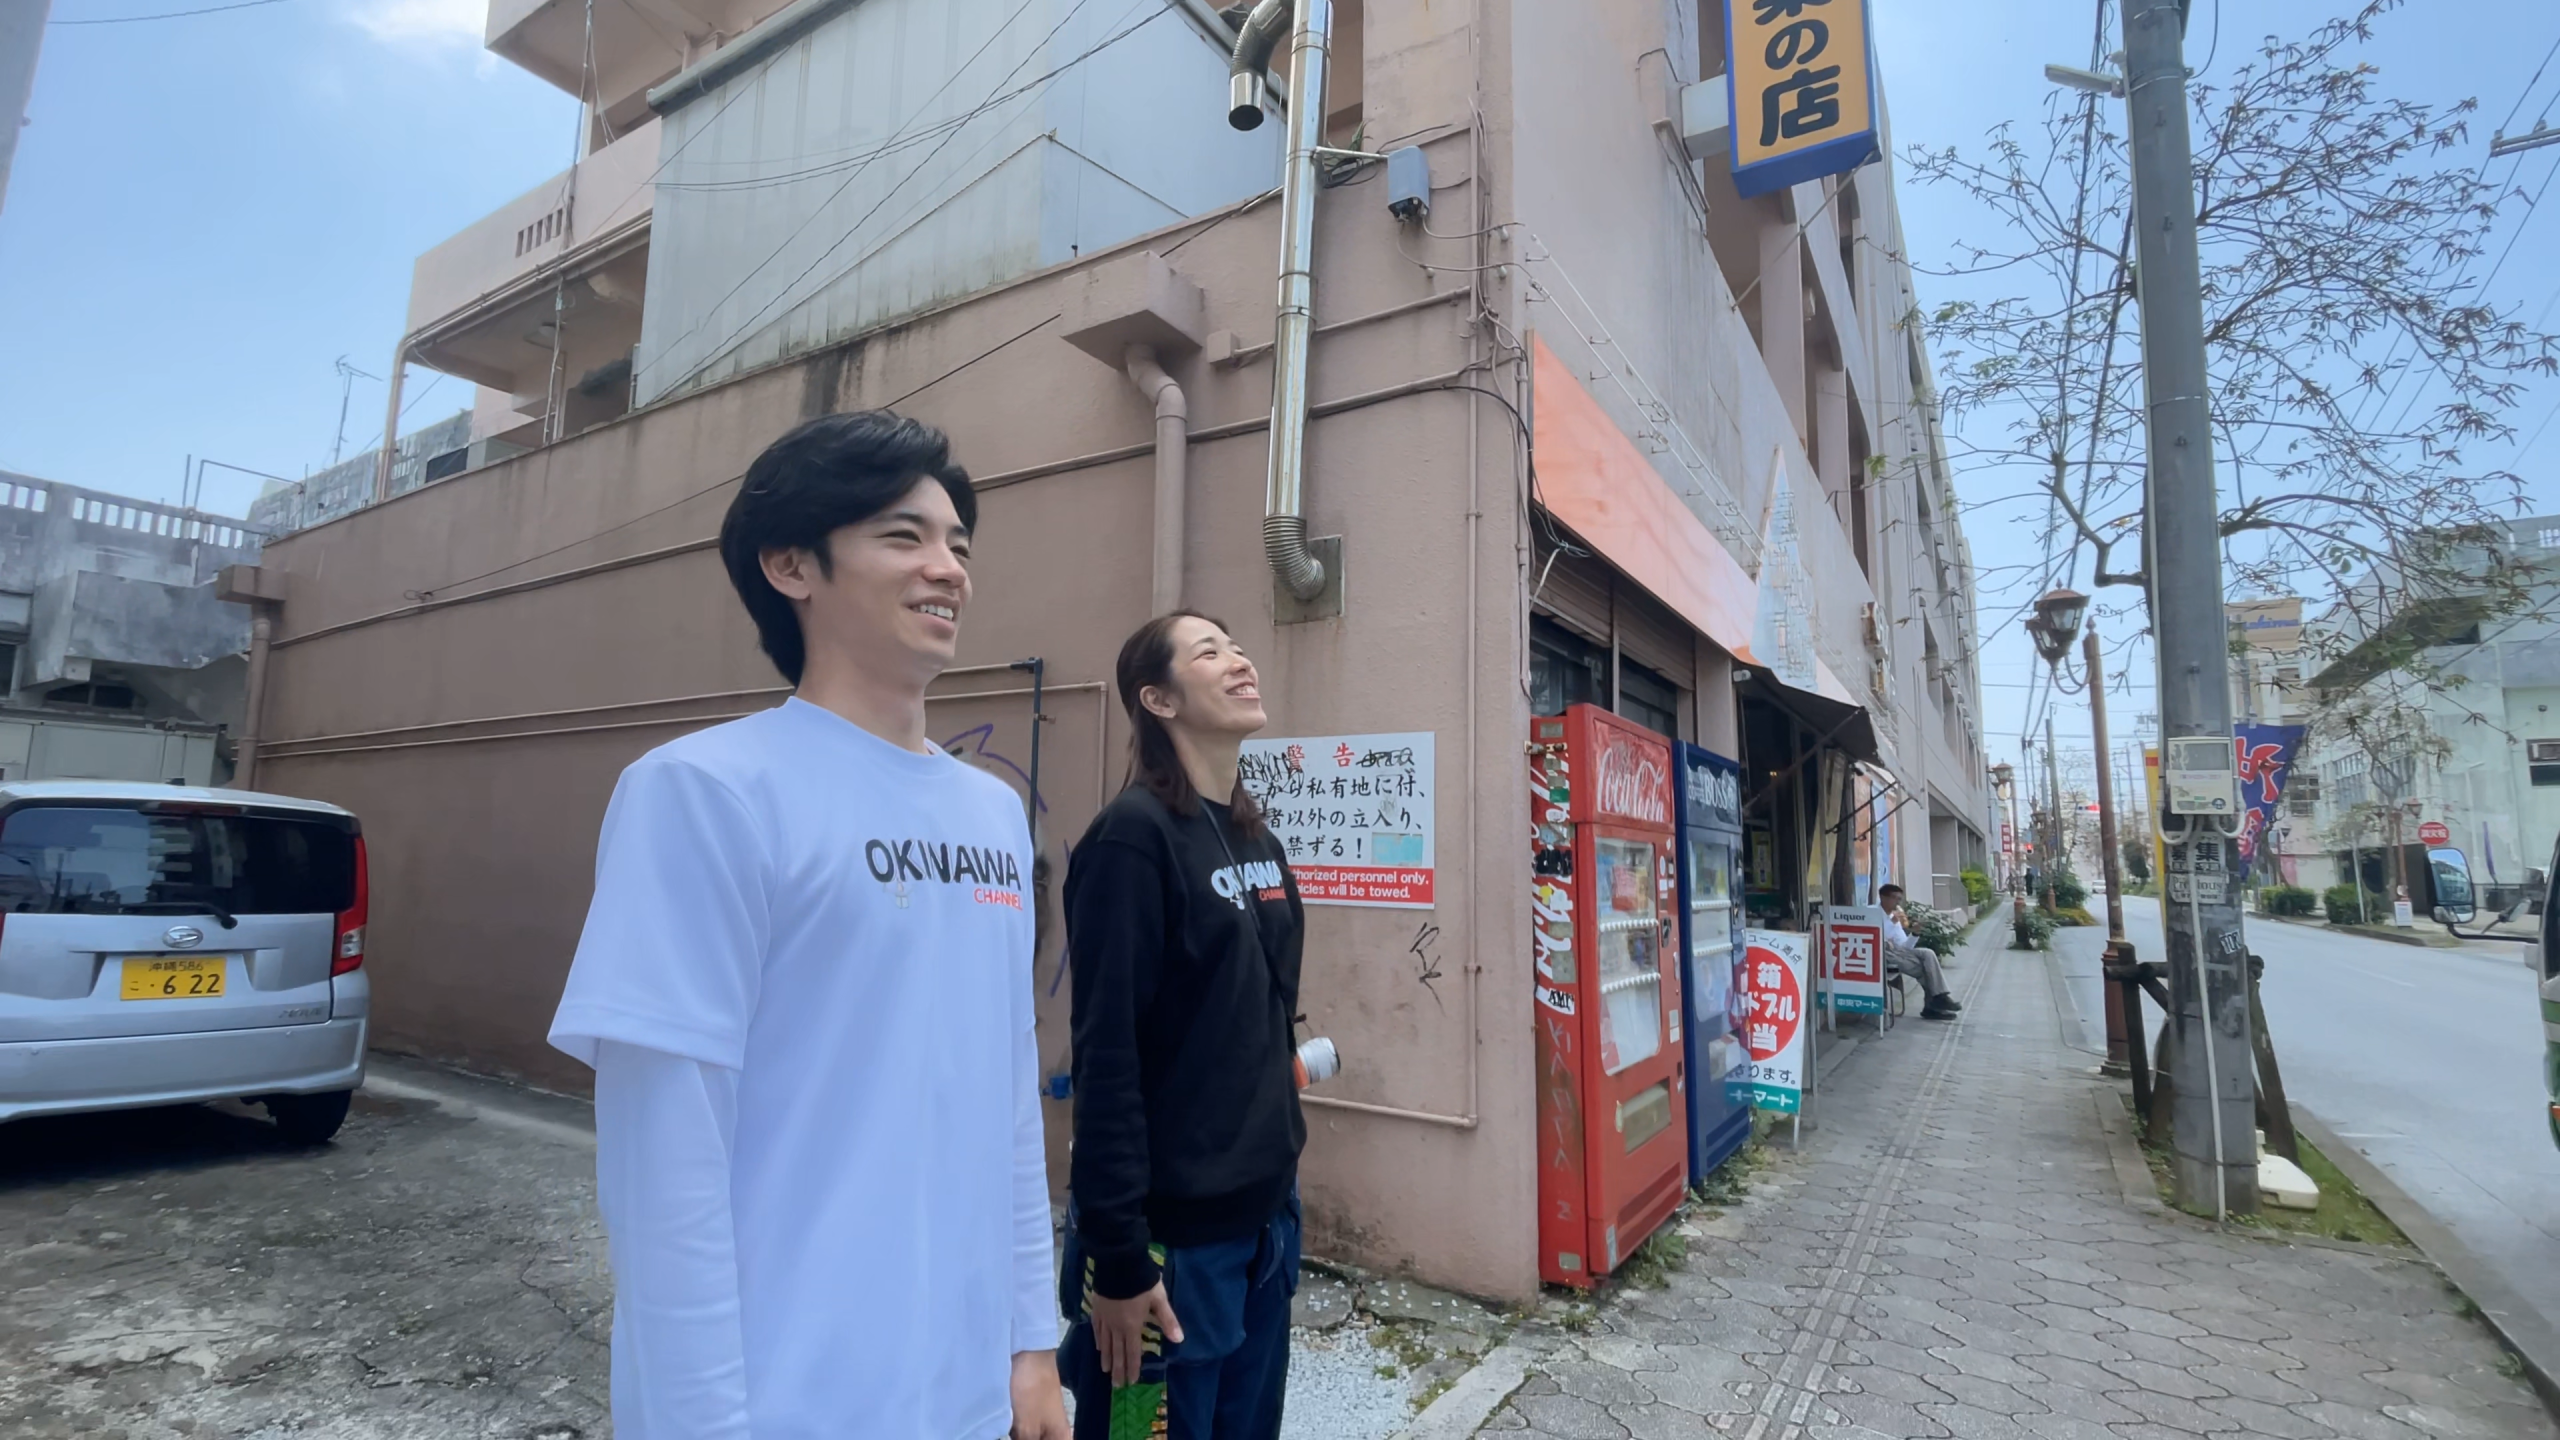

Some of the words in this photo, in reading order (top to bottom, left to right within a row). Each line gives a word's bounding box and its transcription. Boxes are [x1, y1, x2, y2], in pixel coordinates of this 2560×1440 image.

[1704, 773, 1728, 810] BOSS
[865, 838, 1022, 891] OKINAWA
[1339, 870, 1397, 883] personnel
[1400, 871, 1429, 886] only.
[973, 887, 1023, 911] CHANNEL
[1328, 884, 1347, 896] will
[1350, 884, 1365, 897] be
[1369, 885, 1411, 899] towed.
[1833, 911, 1867, 922] Liquor
[1832, 931, 1875, 977] 酒
